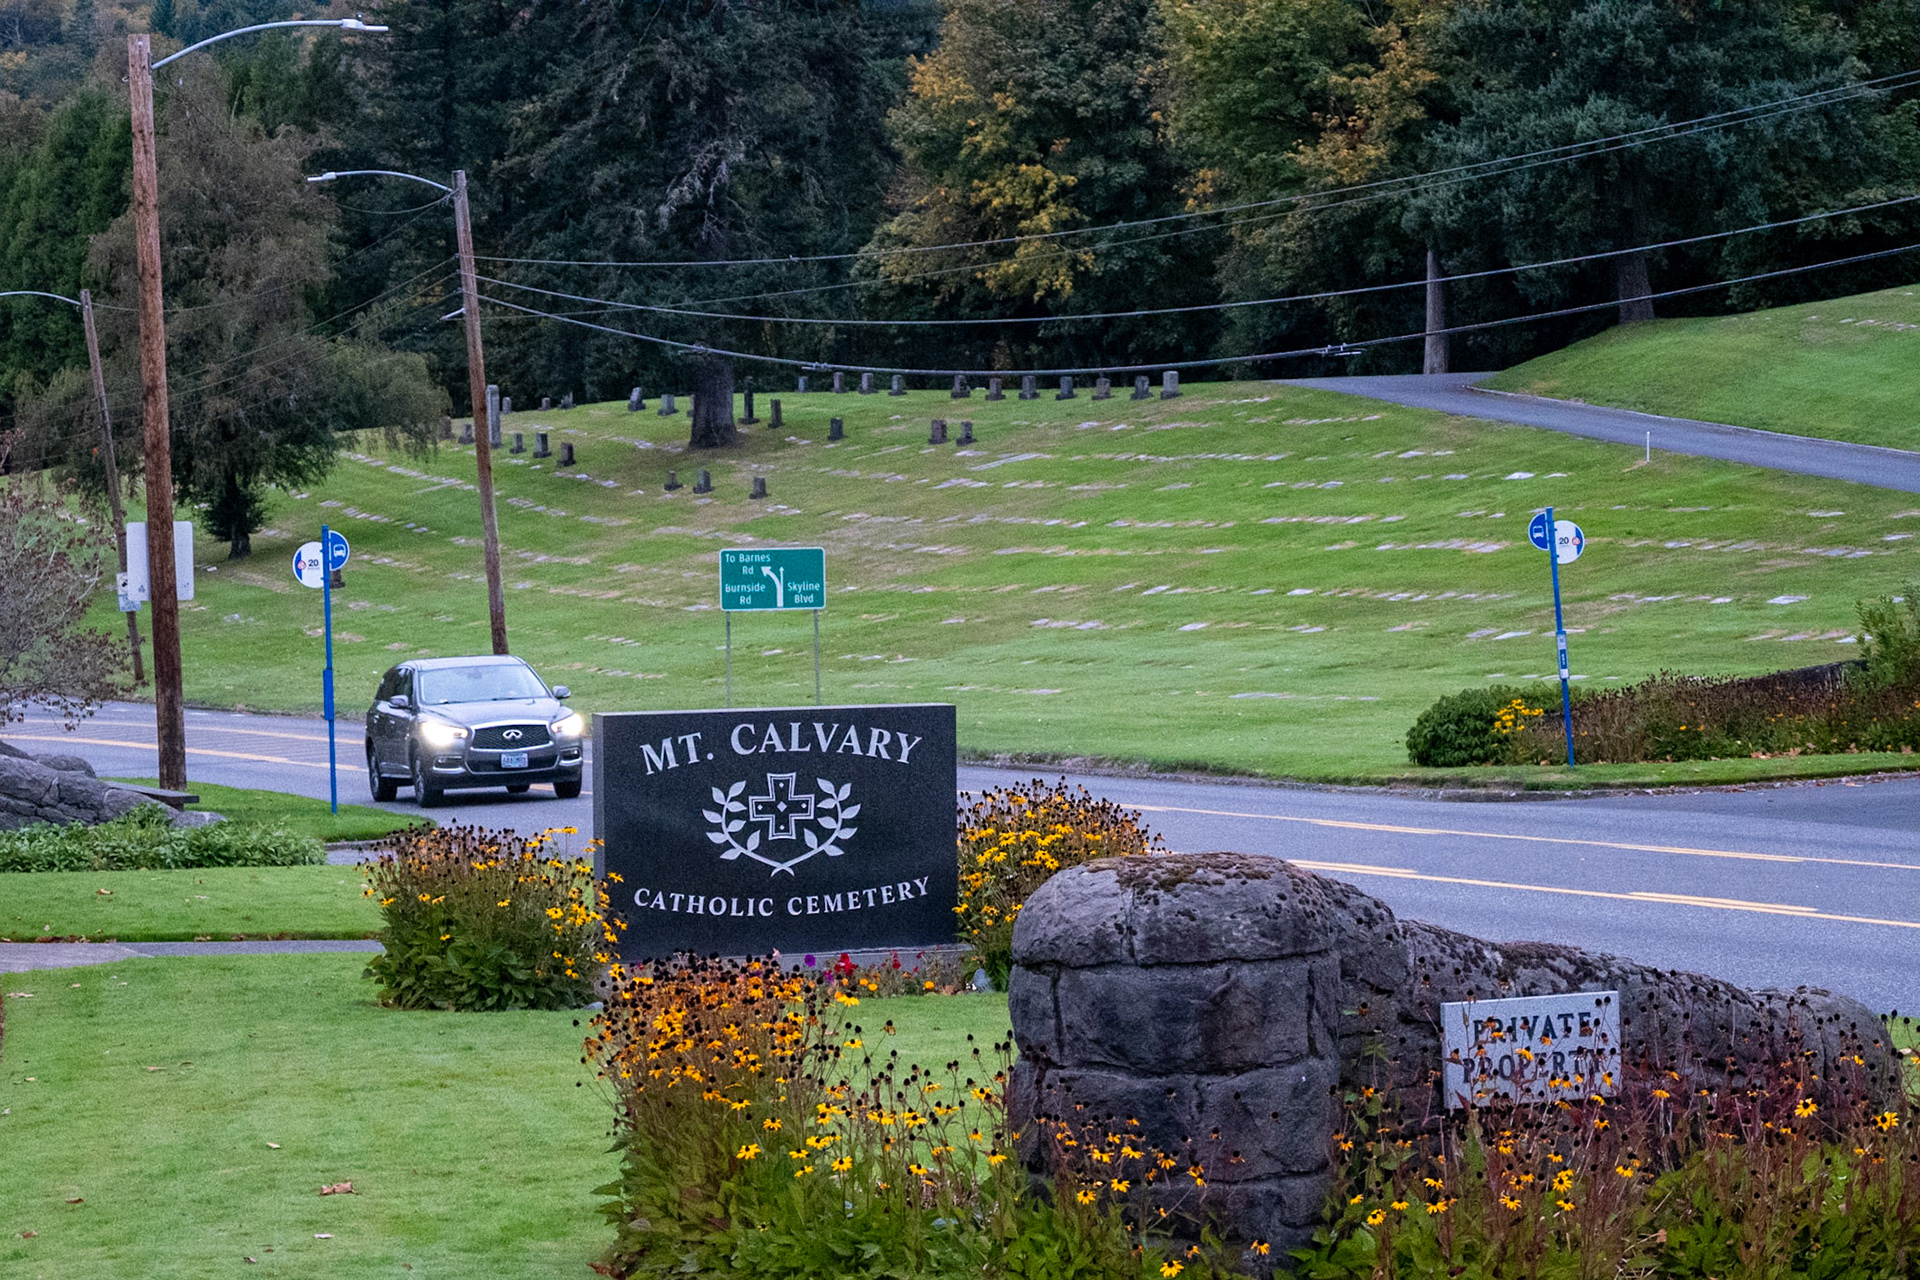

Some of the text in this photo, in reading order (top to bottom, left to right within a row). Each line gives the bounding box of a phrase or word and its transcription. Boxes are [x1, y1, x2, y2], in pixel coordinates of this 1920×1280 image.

[725, 553, 771, 562] To Barnes
[742, 565, 754, 575] Rd
[725, 583, 766, 592] Burnside
[787, 581, 820, 593] Skyline
[739, 595, 752, 605] Rd
[794, 593, 814, 604] Blvd
[639, 722, 922, 775] MT. CALVARY
[633, 876, 930, 917] CATHOLIC CEMETERY
[1473, 1012, 1591, 1044] PRIVATE
